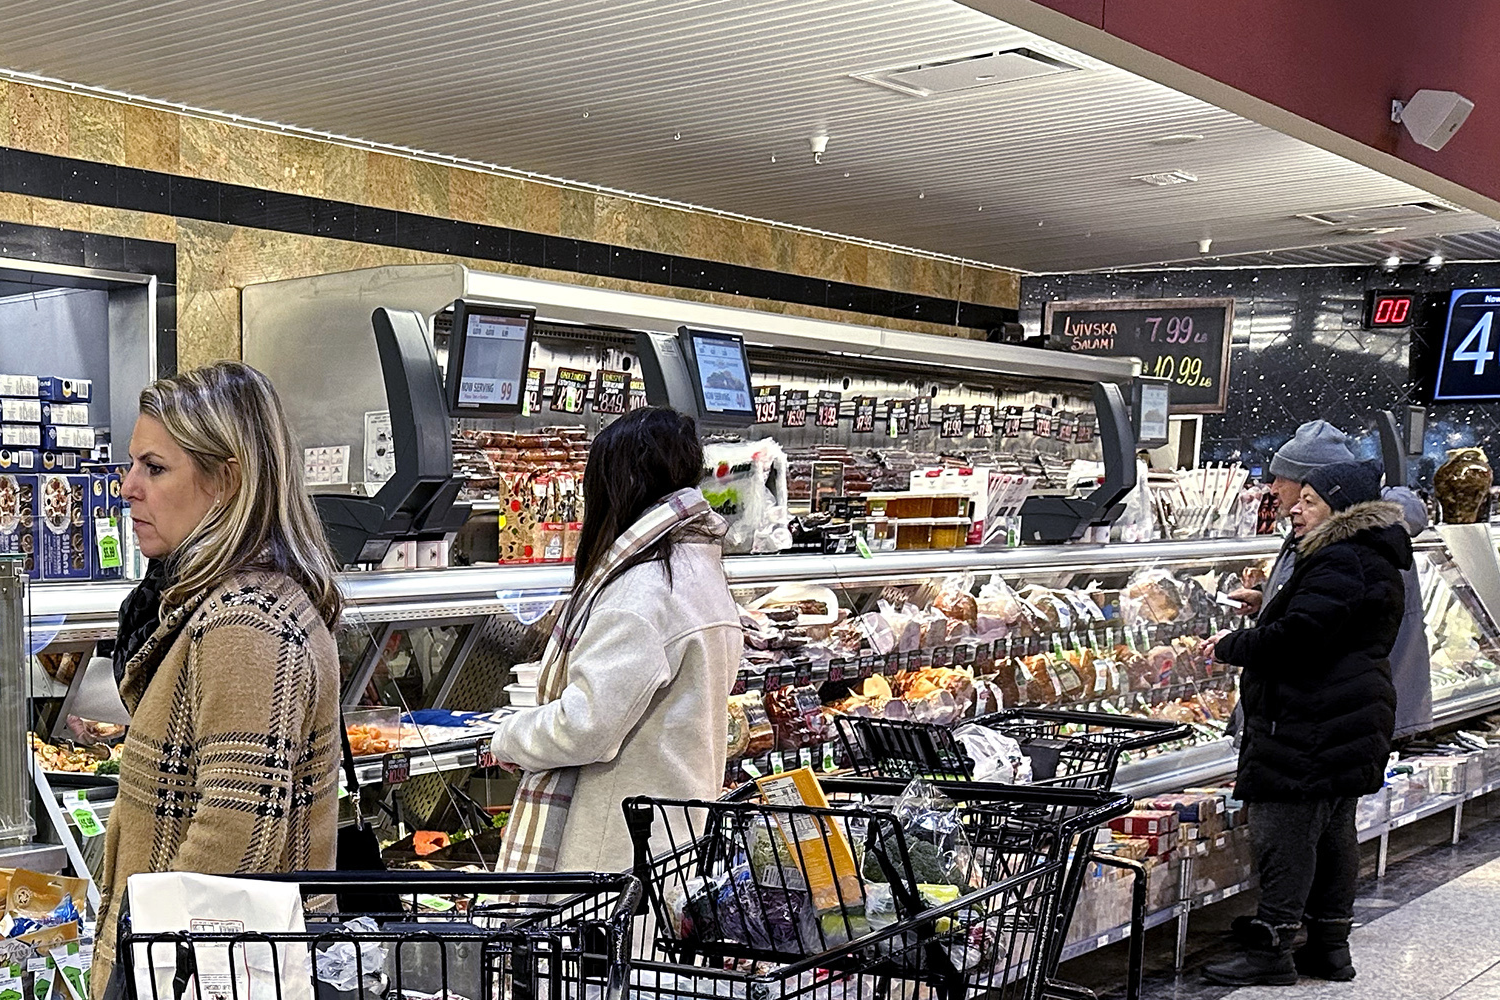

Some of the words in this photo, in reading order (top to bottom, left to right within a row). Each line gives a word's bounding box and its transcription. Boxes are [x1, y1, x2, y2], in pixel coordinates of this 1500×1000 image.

[1375, 300, 1410, 323] 00
[1064, 316, 1117, 336] LVIVSKA
[1071, 335, 1114, 350] SALAMI
[501, 382, 512, 400] 99
